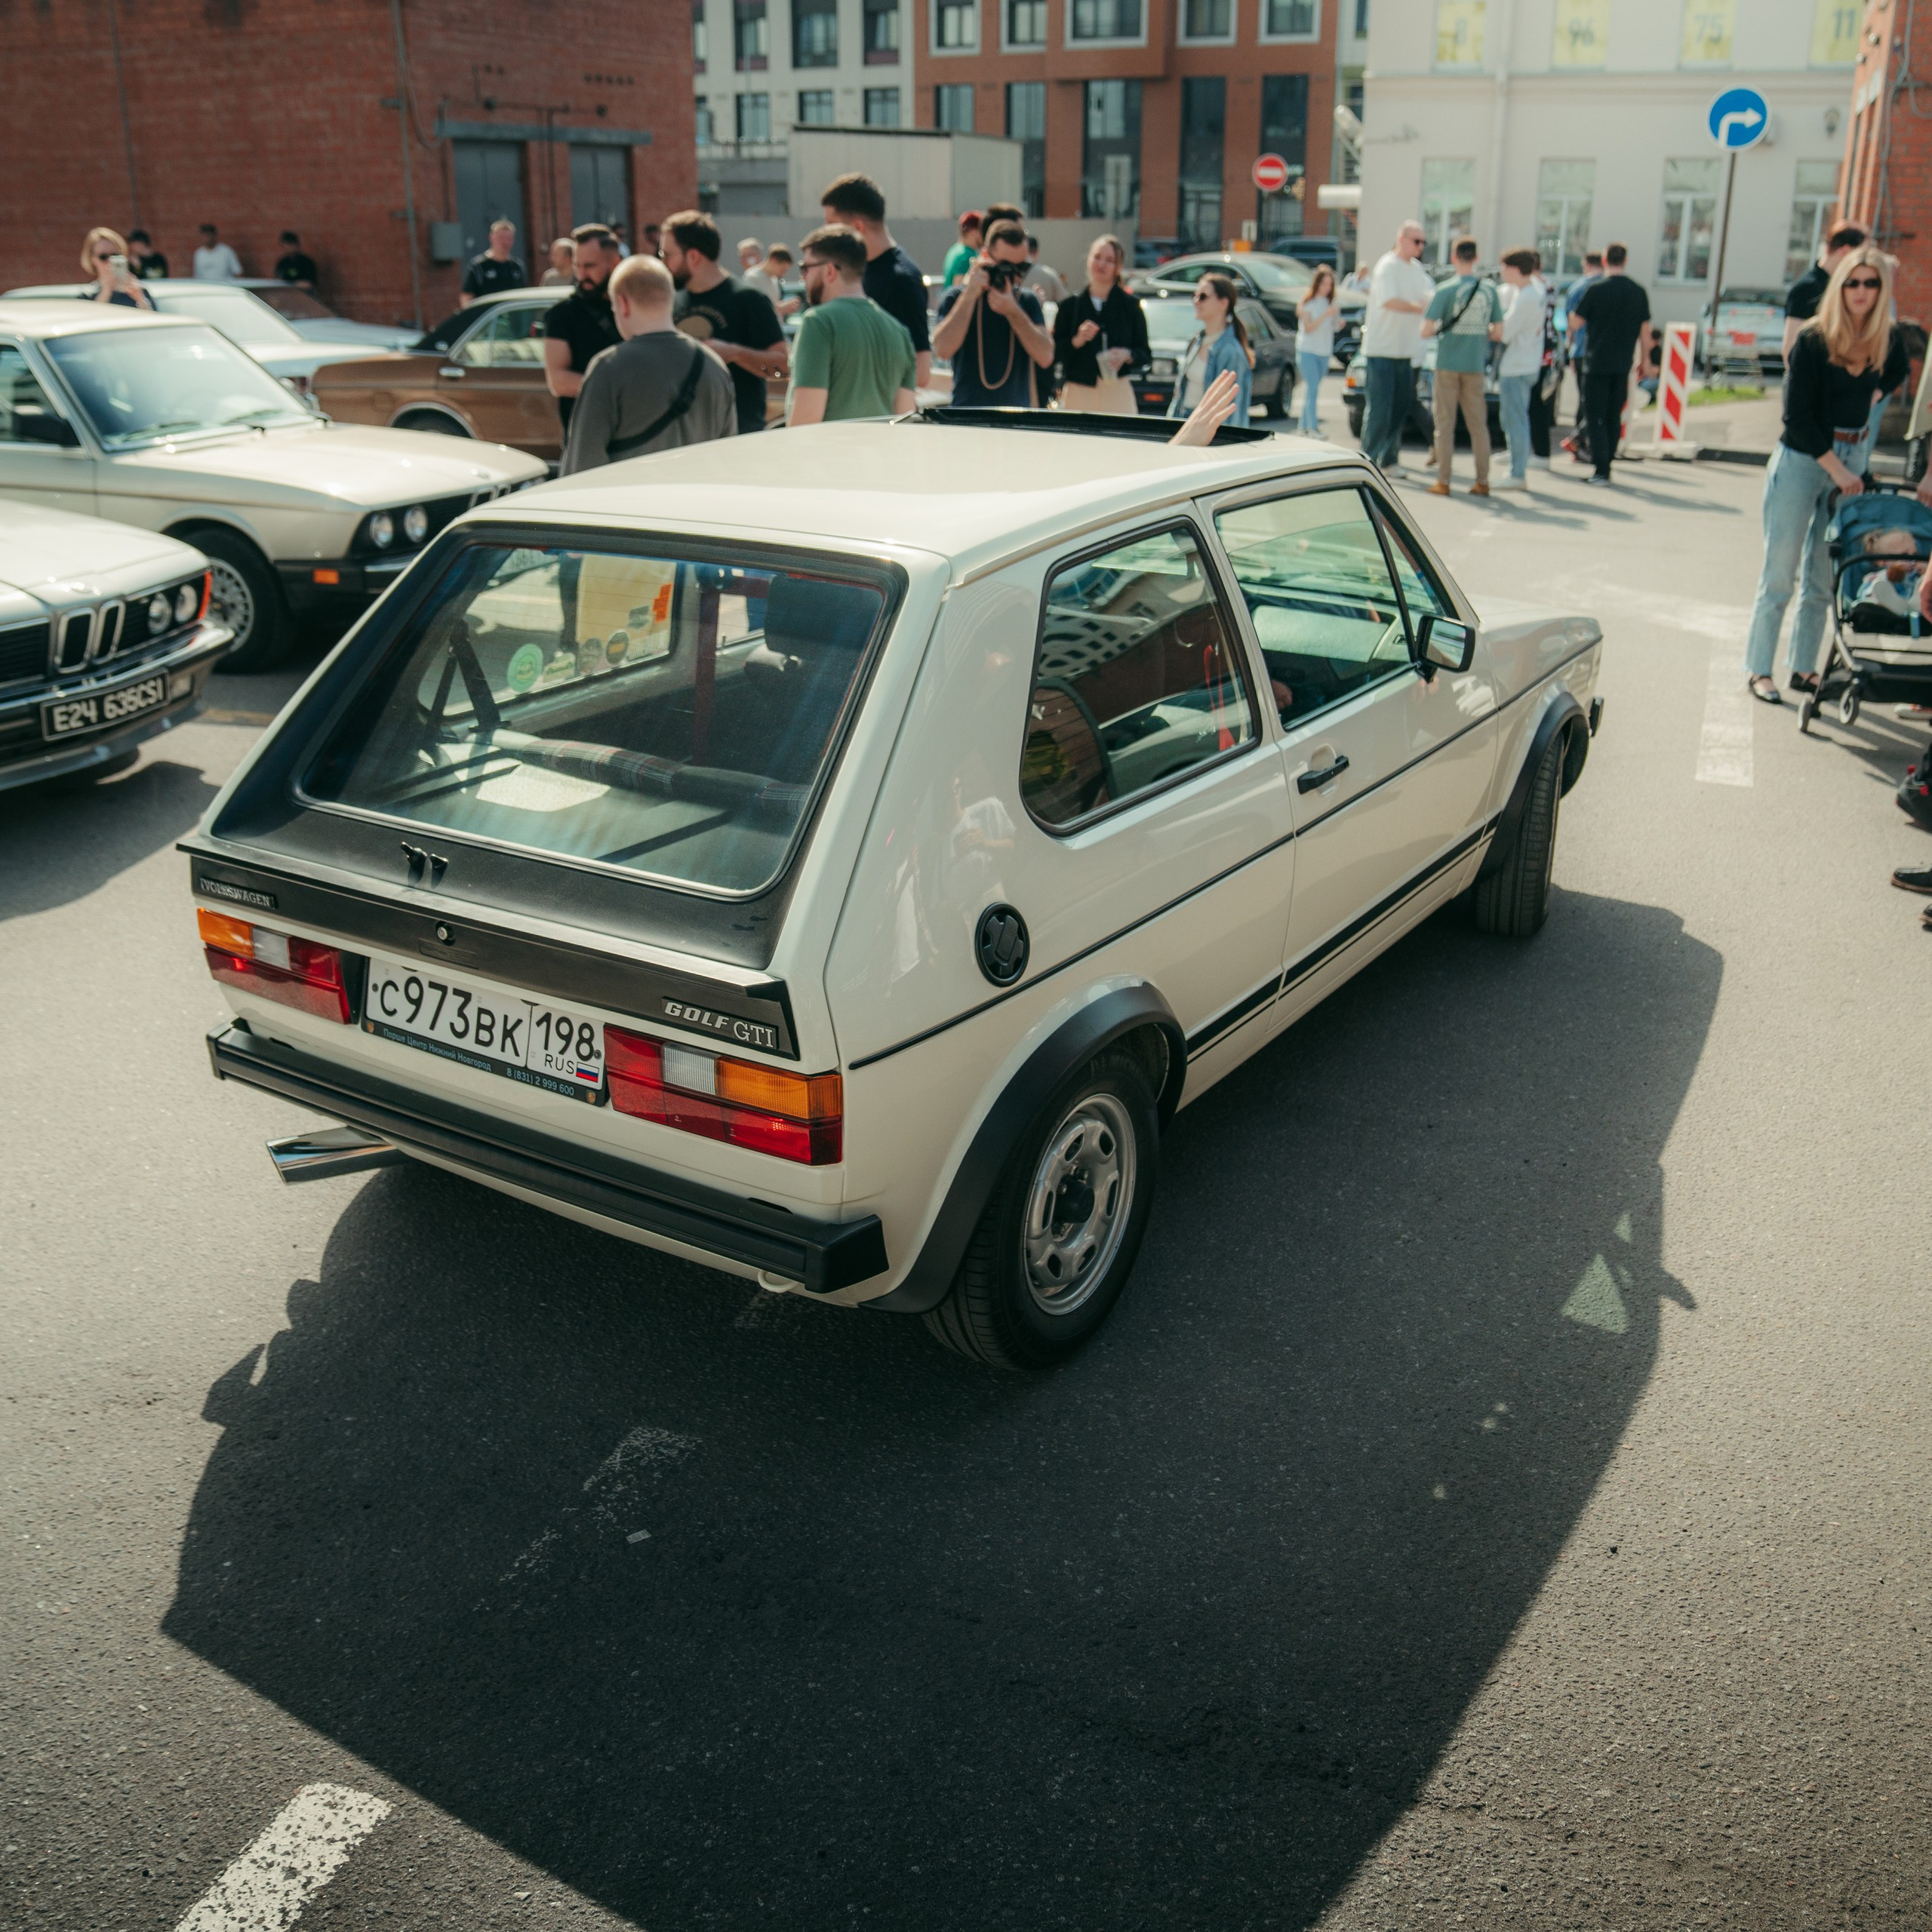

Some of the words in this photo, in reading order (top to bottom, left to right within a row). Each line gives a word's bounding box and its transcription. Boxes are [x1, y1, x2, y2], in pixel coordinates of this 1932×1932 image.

[1568, 17, 1595, 47] 96
[1693, 13, 1725, 44] 75
[1833, 8, 1857, 39] 11
[52, 699, 99, 732] E24
[103, 676, 165, 720] 635CSI
[204, 881, 272, 907] VOLKSWAGEN
[536, 1012, 595, 1061] 198
[665, 1001, 730, 1029] GOLF
[734, 1021, 774, 1048] GTI
[383, 1028, 406, 1044] Порше
[406, 1035, 428, 1052] Центр
[429, 1043, 457, 1060] Нижний
[457, 1051, 492, 1072] Новгород
[544, 1054, 575, 1075] RUS
[506, 1067, 512, 1077] 8
[514, 1069, 534, 1084] (831)
[535, 1075, 540, 1085] 2
[542, 1078, 558, 1091] 999
[559, 1083, 575, 1096] 600
